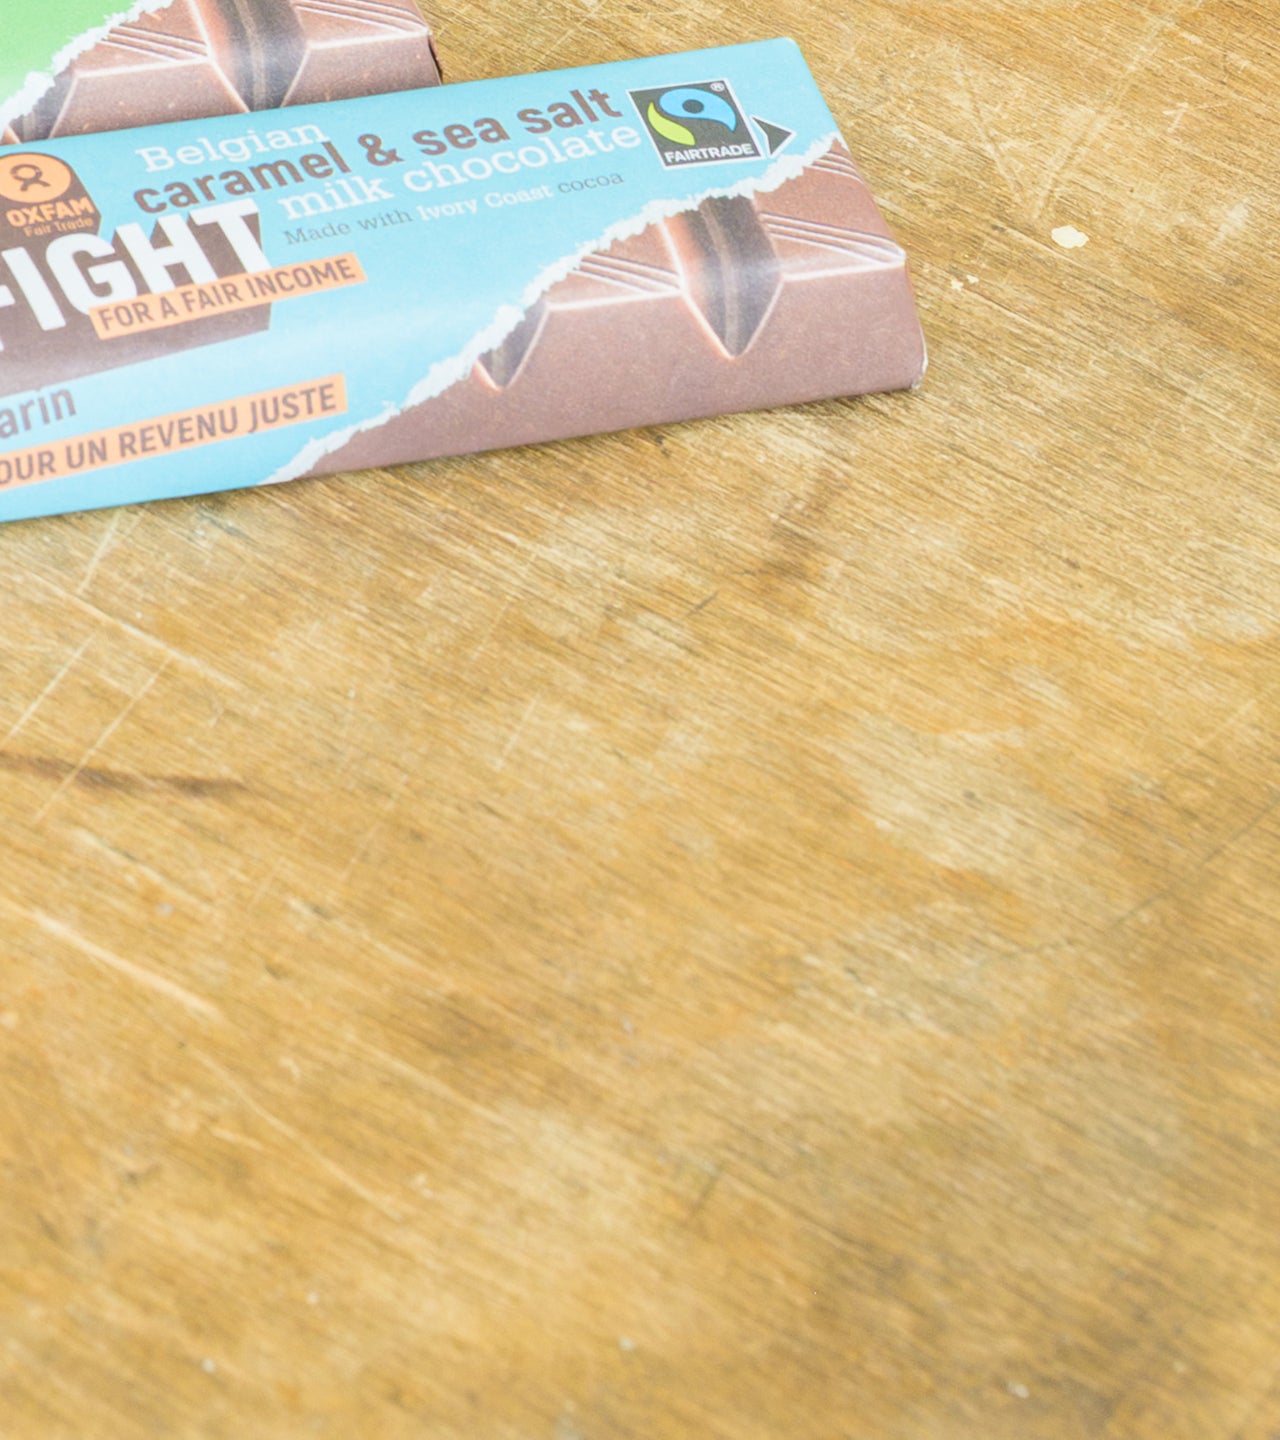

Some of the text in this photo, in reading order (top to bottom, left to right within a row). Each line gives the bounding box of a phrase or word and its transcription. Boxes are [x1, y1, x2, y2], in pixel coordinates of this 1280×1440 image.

[131, 90, 624, 217] caramel & sea salt
[135, 119, 331, 174] Belgian
[276, 123, 639, 221] milk chocolate
[664, 141, 755, 165] FAIRTRADE
[5, 196, 94, 227] OXFAM
[99, 257, 356, 332] FOR A FAIR INCOME
[66, 442, 108, 469] UN
[119, 411, 240, 458] REVENU
[247, 382, 337, 434] JUSTE
